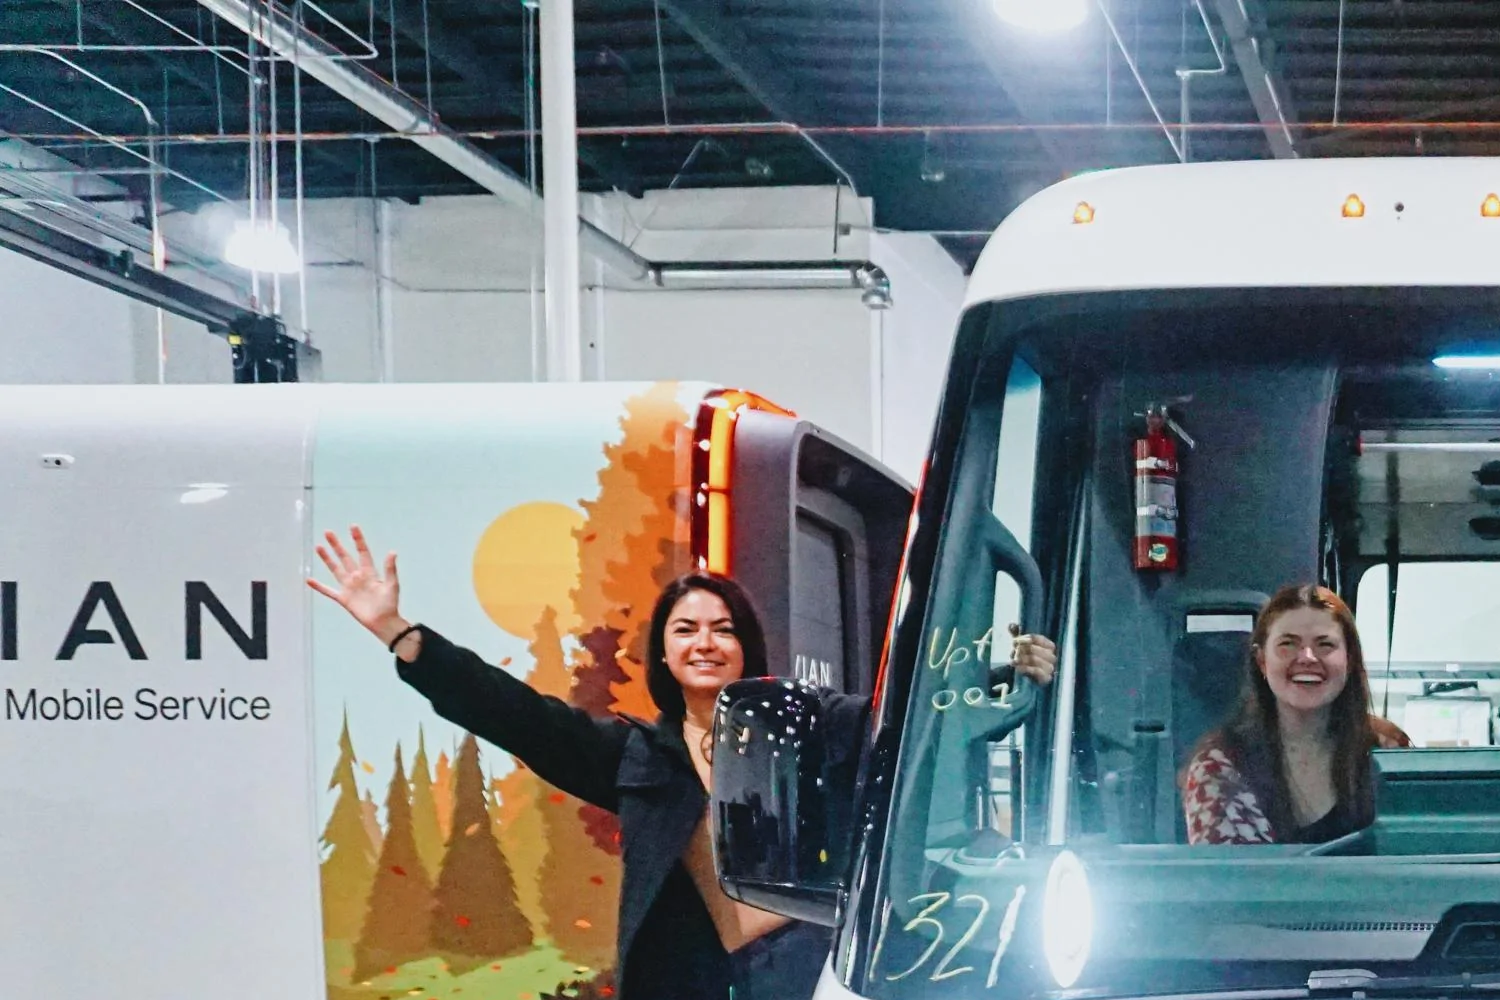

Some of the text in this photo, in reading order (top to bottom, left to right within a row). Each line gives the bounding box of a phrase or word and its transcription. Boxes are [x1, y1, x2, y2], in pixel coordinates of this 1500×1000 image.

[0, 581, 268, 660] IAN
[6, 688, 271, 721] Mobile Service
